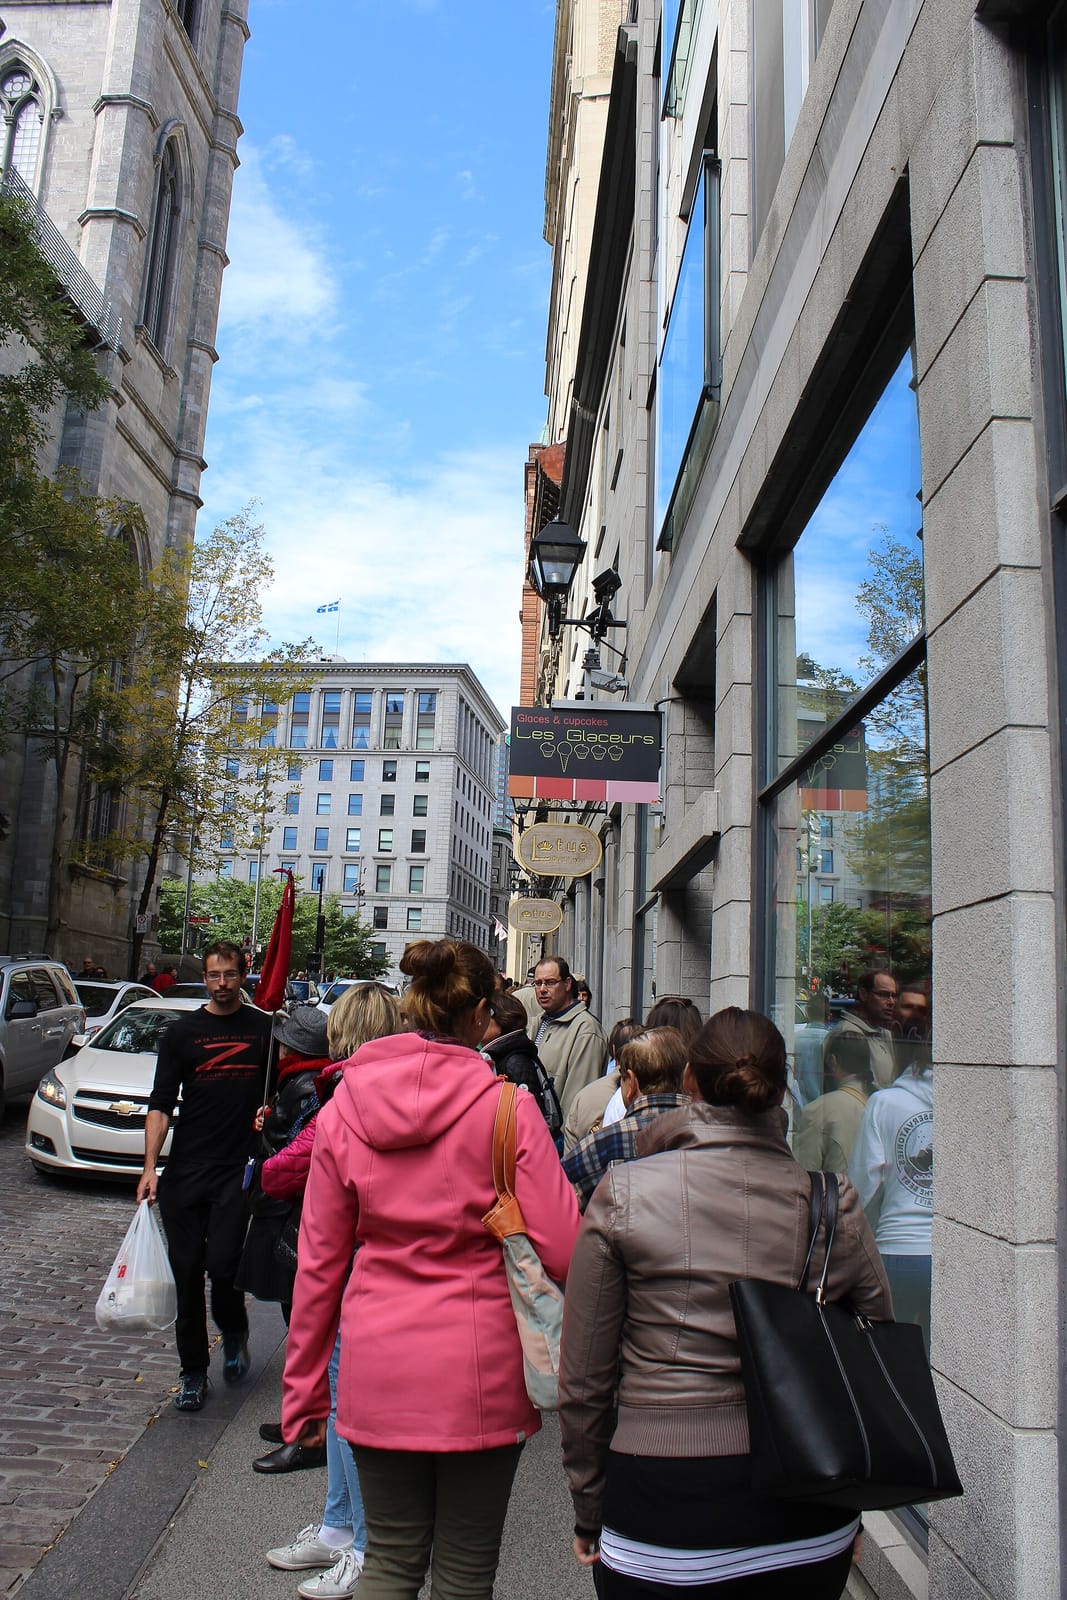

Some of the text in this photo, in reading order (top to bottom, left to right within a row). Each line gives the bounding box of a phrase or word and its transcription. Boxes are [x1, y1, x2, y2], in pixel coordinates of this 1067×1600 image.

[517, 713, 609, 727] Glaces & cupcakes
[516, 726, 655, 745] Les Glaceurs
